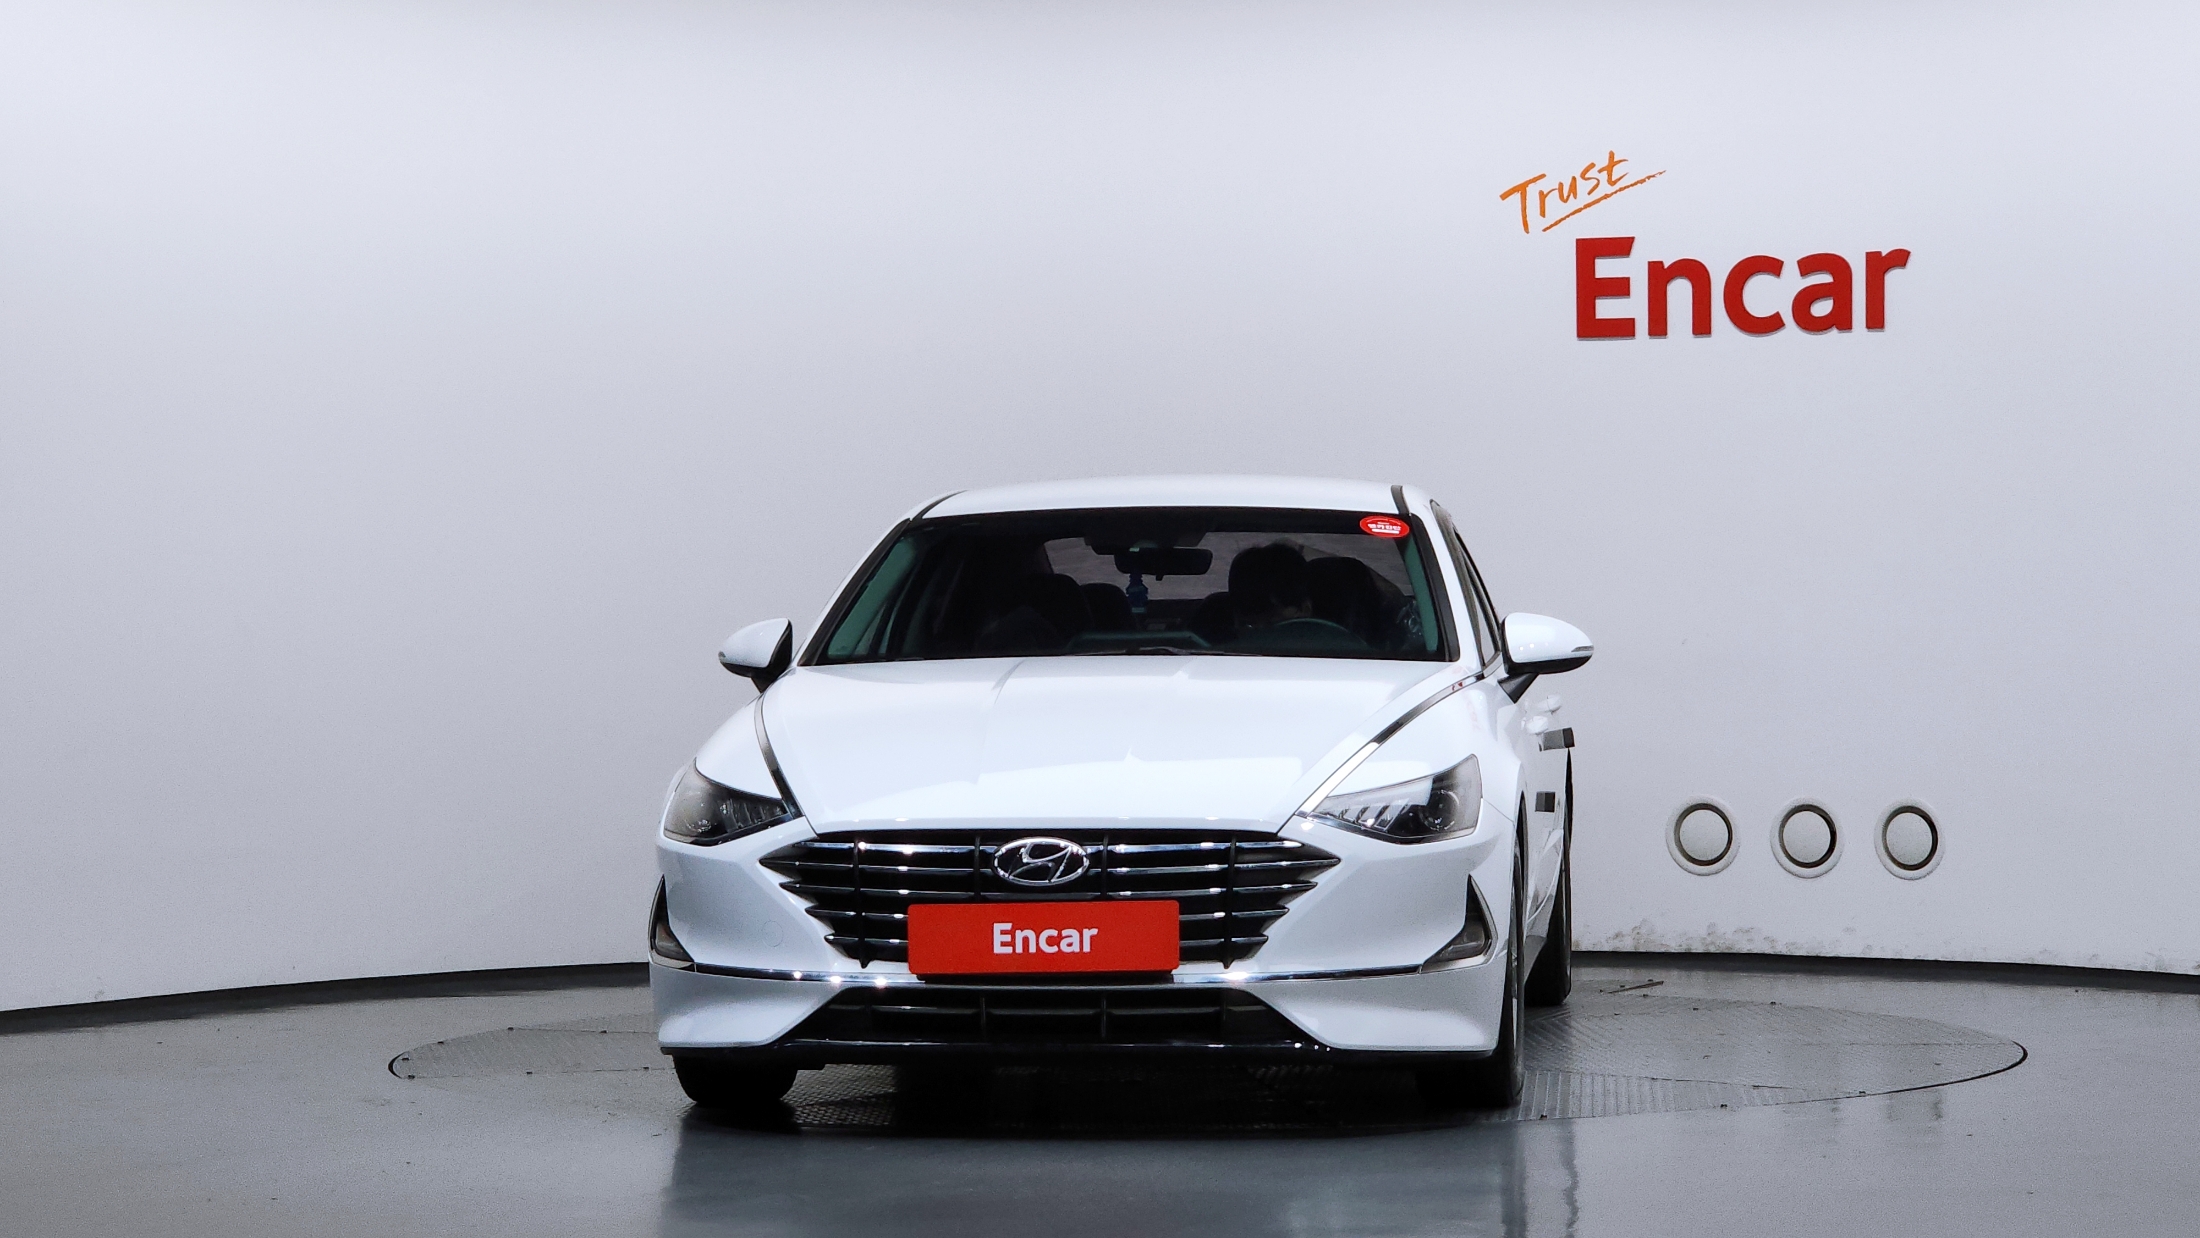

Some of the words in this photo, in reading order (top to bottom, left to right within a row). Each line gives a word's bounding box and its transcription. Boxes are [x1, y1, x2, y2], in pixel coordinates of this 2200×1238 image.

[1500, 150, 1629, 234] Trust
[1575, 236, 1912, 340] Encar
[993, 922, 1099, 954] Encar
